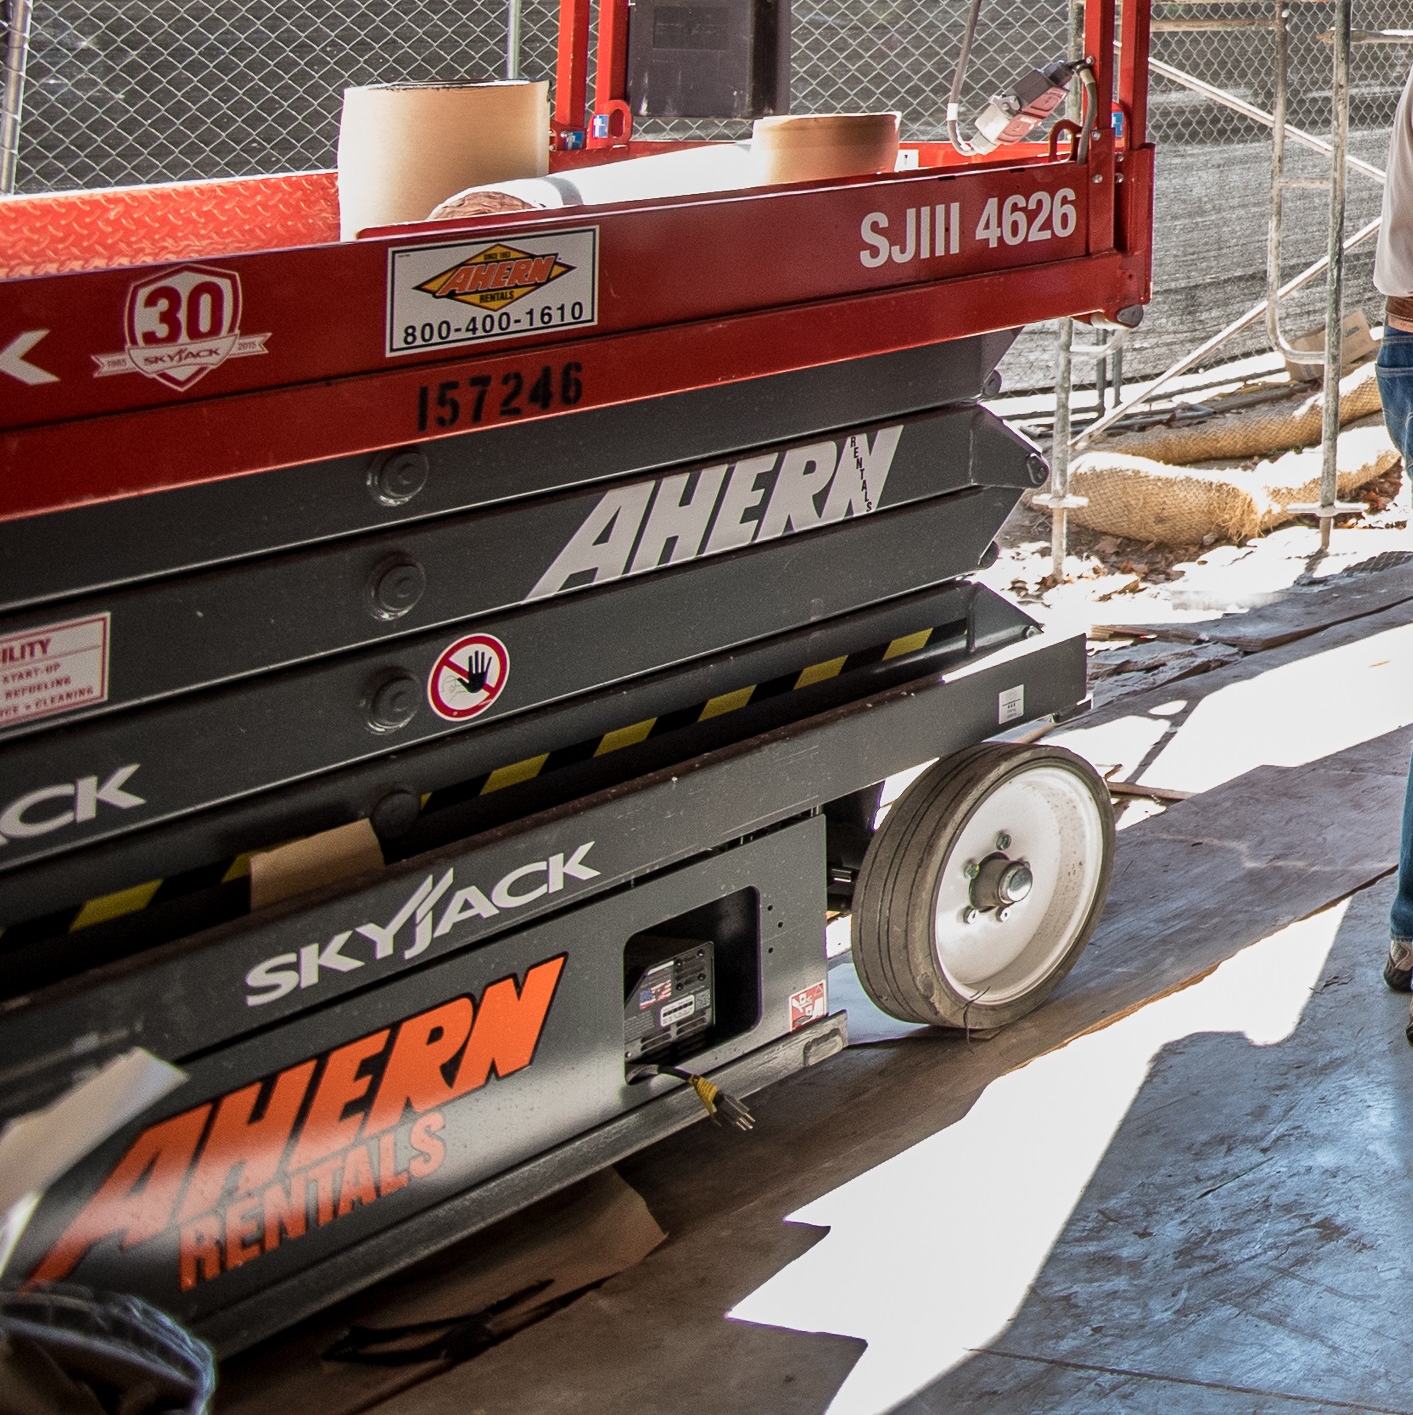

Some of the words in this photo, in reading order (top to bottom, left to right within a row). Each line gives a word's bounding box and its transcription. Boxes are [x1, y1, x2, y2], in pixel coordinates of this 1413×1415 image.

[859, 202, 961, 269] SJIII
[975, 188, 1078, 249] 4626
[435, 256, 556, 296] AHERN
[479, 291, 514, 303] RENTALS
[142, 281, 224, 346] 30
[403, 301, 584, 346] 800-400-1610
[143, 347, 221, 366] SKYJACK
[417, 361, 584, 432] 157246
[849, 435, 873, 513] RENTALS
[521, 425, 904, 604] AHERN
[245, 841, 601, 1006] SKYJACK
[20, 952, 568, 1294] AHERN
[179, 1112, 447, 1293] RENTALS
